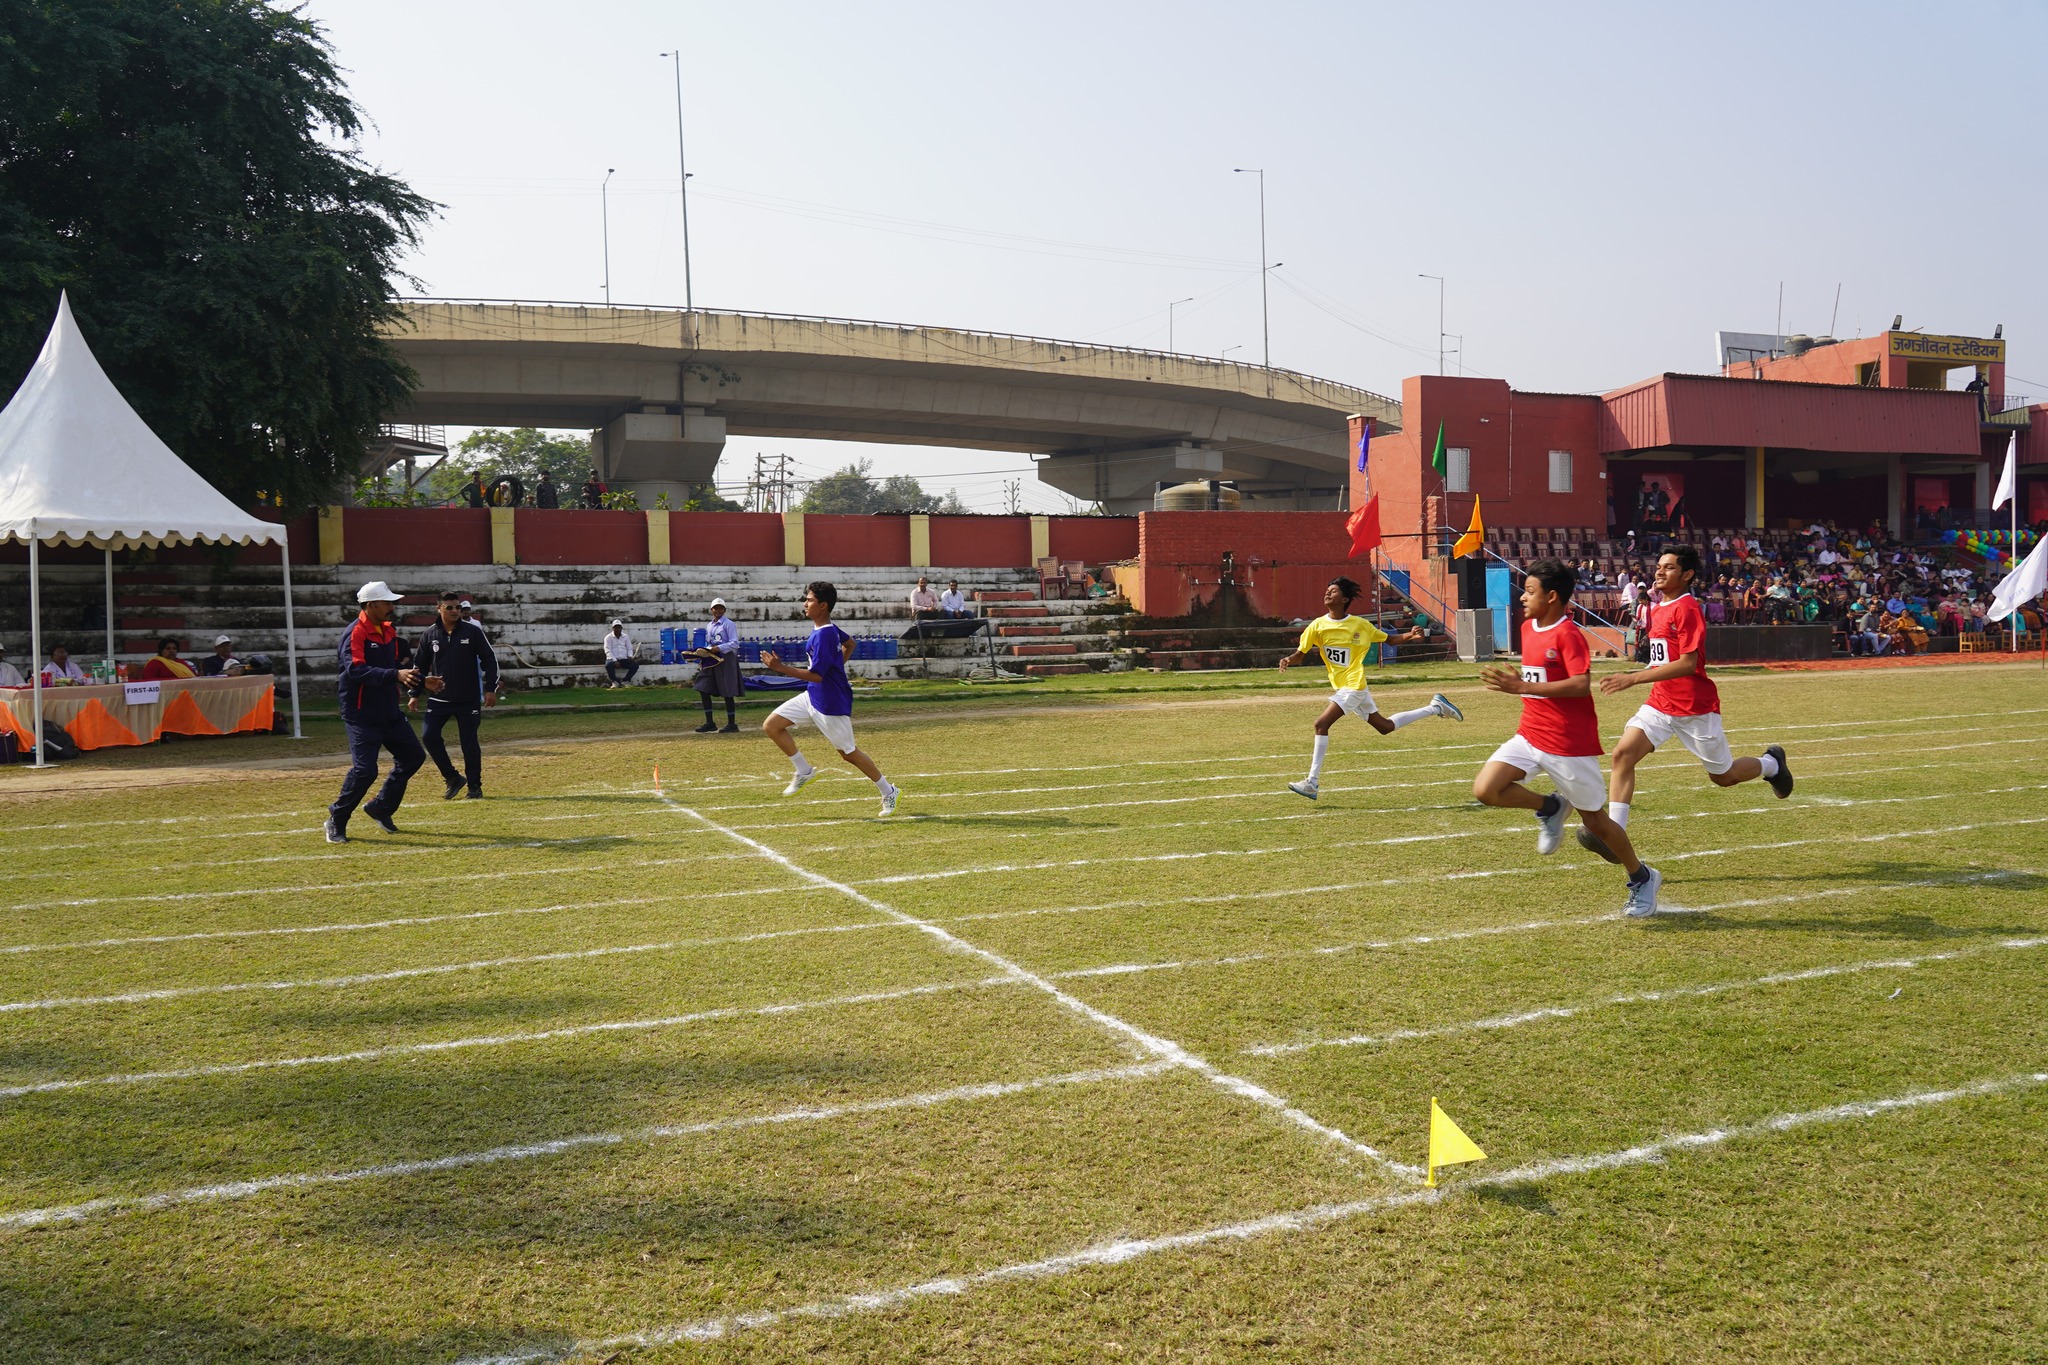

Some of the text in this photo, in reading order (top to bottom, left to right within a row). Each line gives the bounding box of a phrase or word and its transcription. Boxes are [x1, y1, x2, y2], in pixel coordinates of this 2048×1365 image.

[1893, 337, 2000, 358] जगजीवन स्टेडियम
[1326, 648, 1346, 664] 251
[126, 686, 160, 694] FIRST-AID
